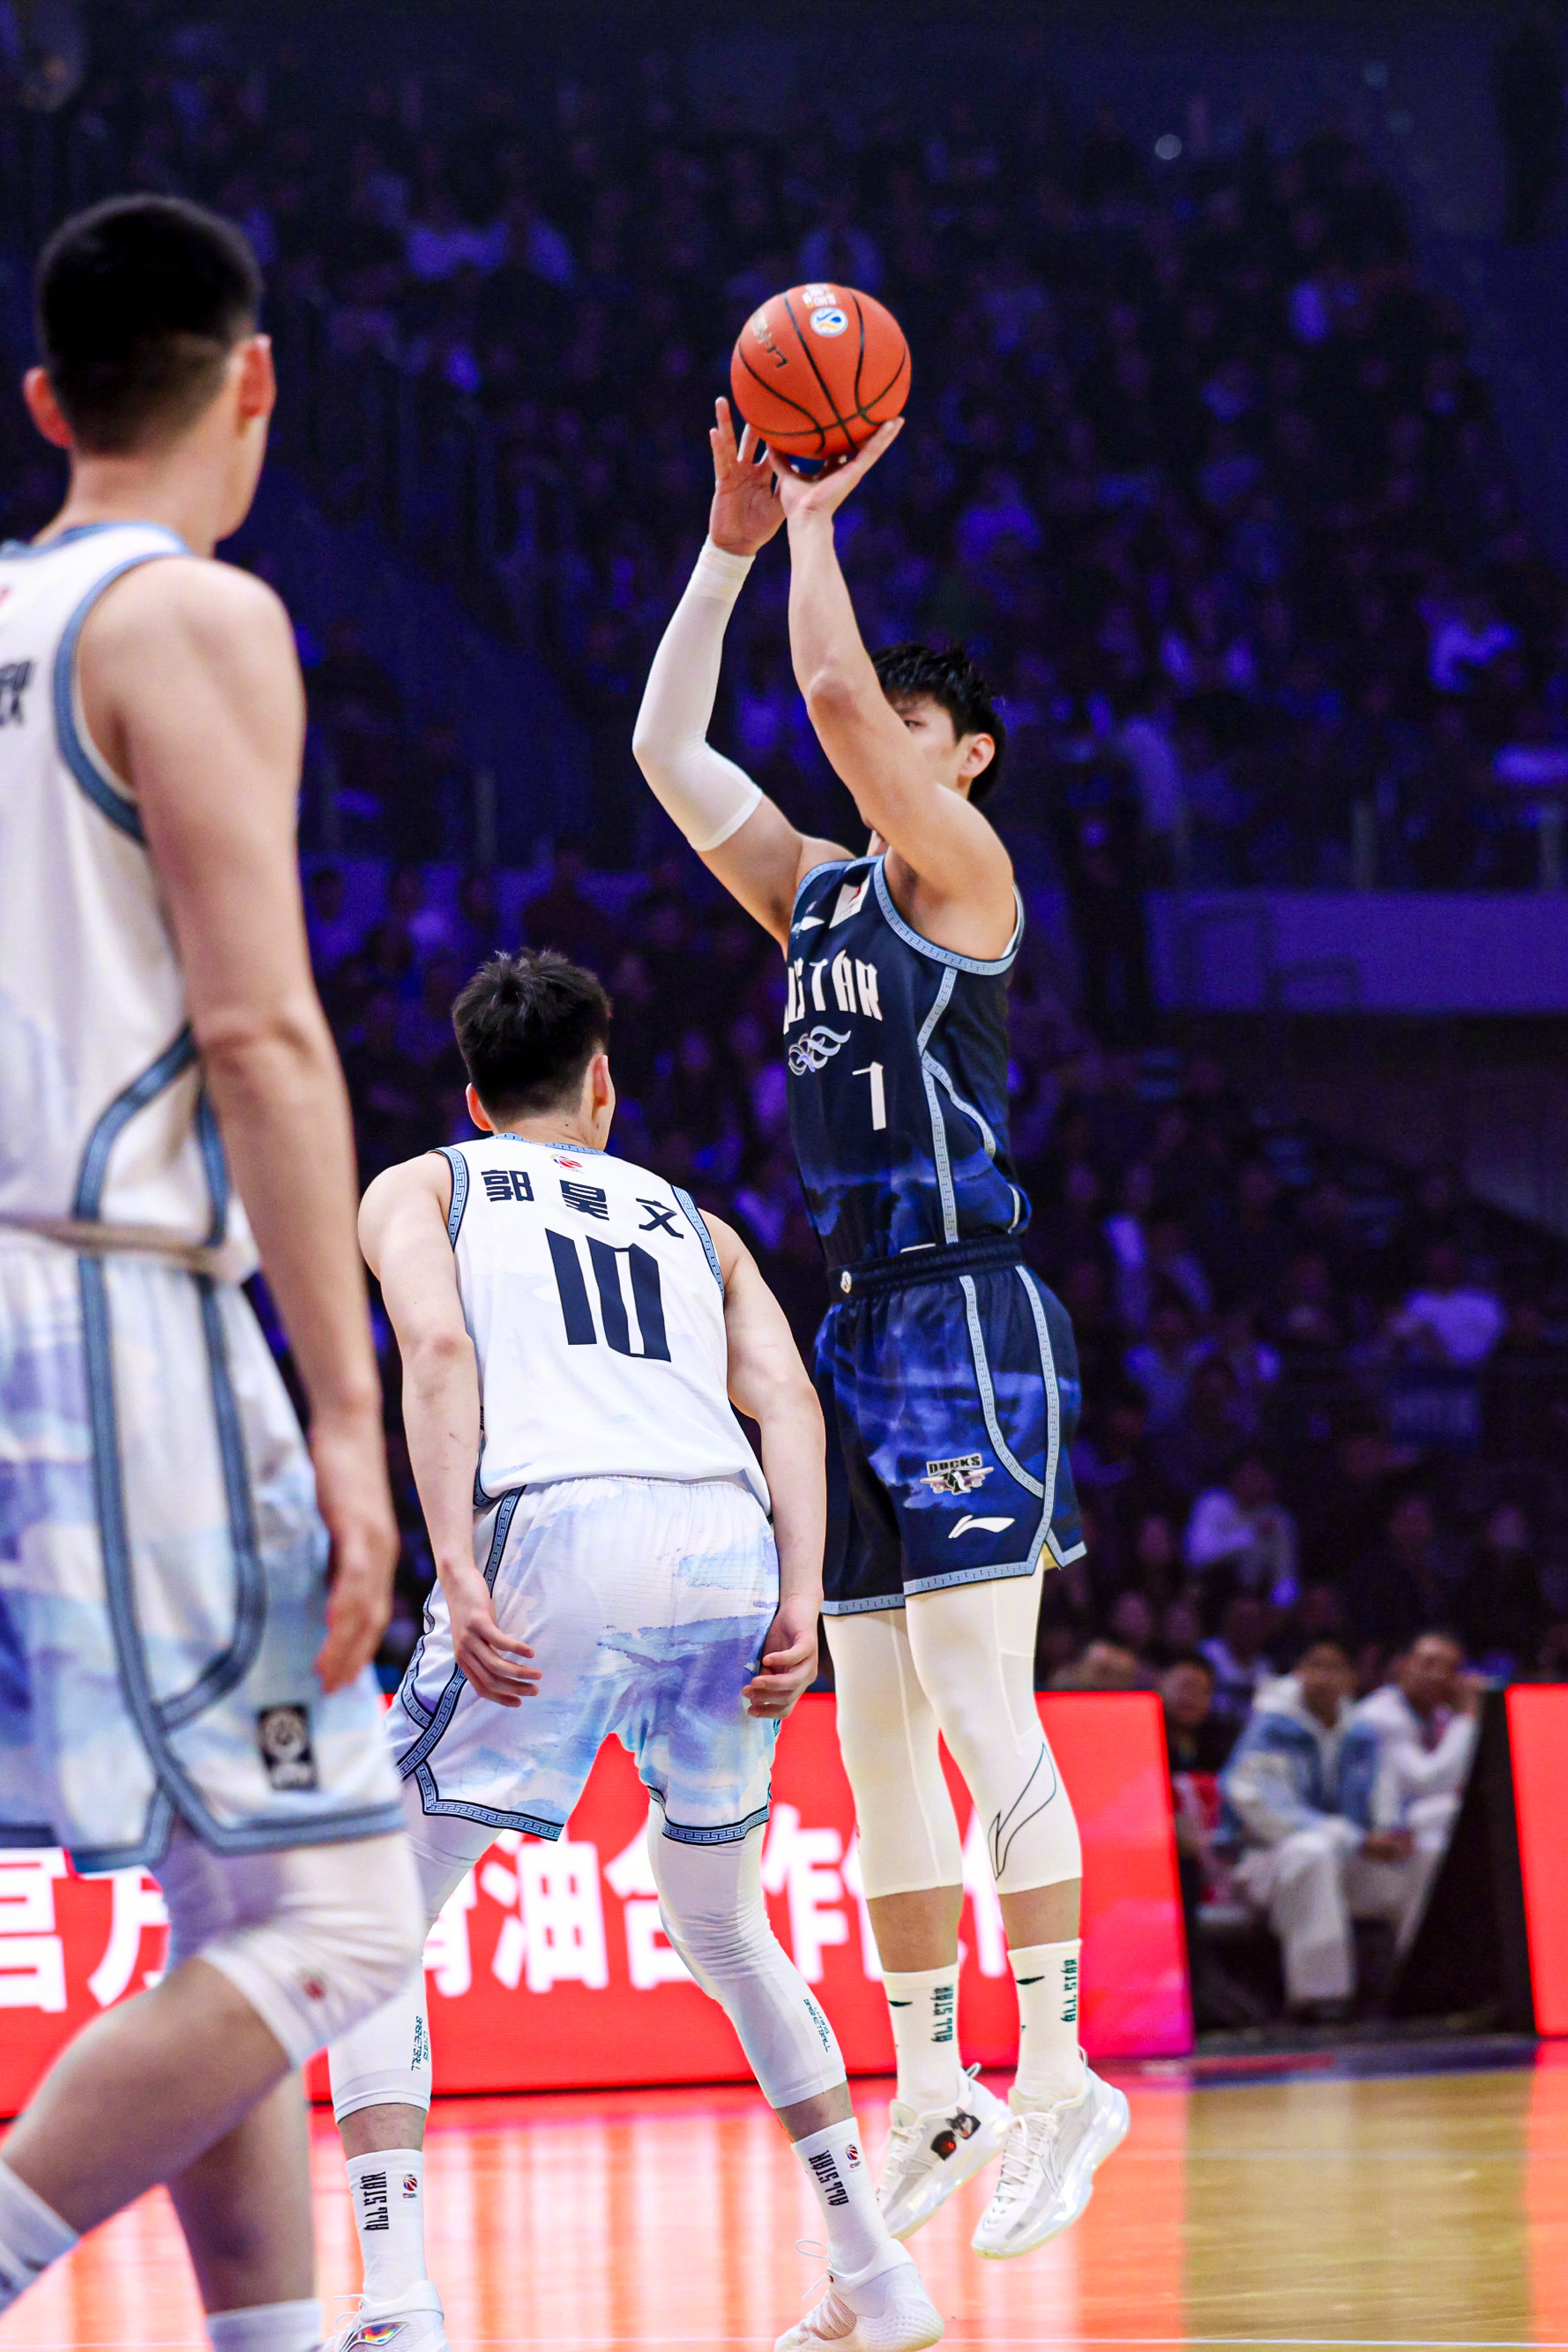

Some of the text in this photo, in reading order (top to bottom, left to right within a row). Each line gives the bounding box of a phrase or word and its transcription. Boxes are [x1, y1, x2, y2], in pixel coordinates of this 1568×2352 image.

[852, 1061, 886, 1131] 1
[481, 1169, 684, 1239] 郭昊文
[544, 1227, 672, 1363] 10
[929, 1455, 981, 1474] DUCKS
[929, 1983, 954, 2042] ALL STAR
[1060, 1958, 1078, 2022] ALL STAR
[359, 2170, 390, 2230] ALL STAR
[808, 2148, 849, 2206] ALL STAR
